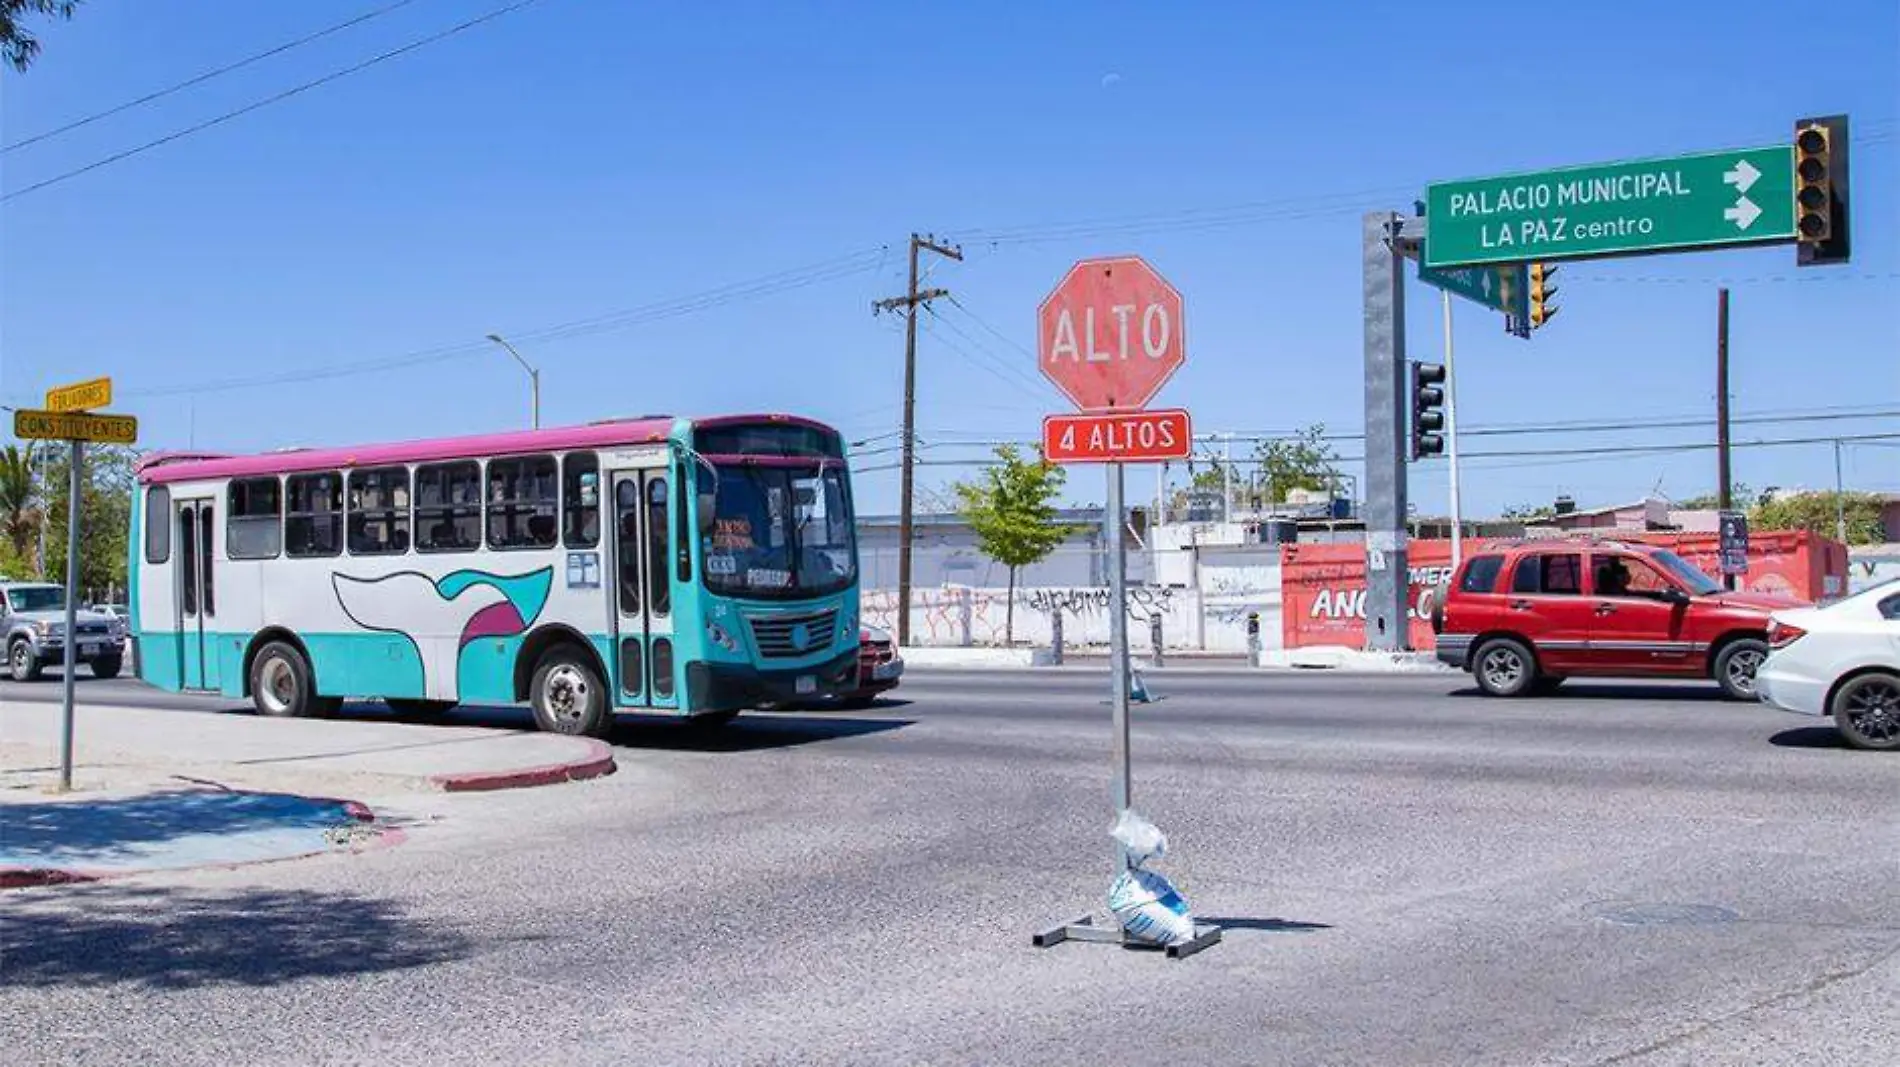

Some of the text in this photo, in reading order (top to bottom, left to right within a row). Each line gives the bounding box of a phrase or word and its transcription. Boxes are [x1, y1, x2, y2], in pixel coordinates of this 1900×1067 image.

[1450, 171, 1691, 216] PALACIO MUNICIPAL
[1482, 216, 1653, 248] LA PAZ centro
[1050, 303, 1170, 363] ALTO
[19, 415, 132, 437] CONSTITUYENTES
[1059, 419, 1175, 451] 4 ALTOS
